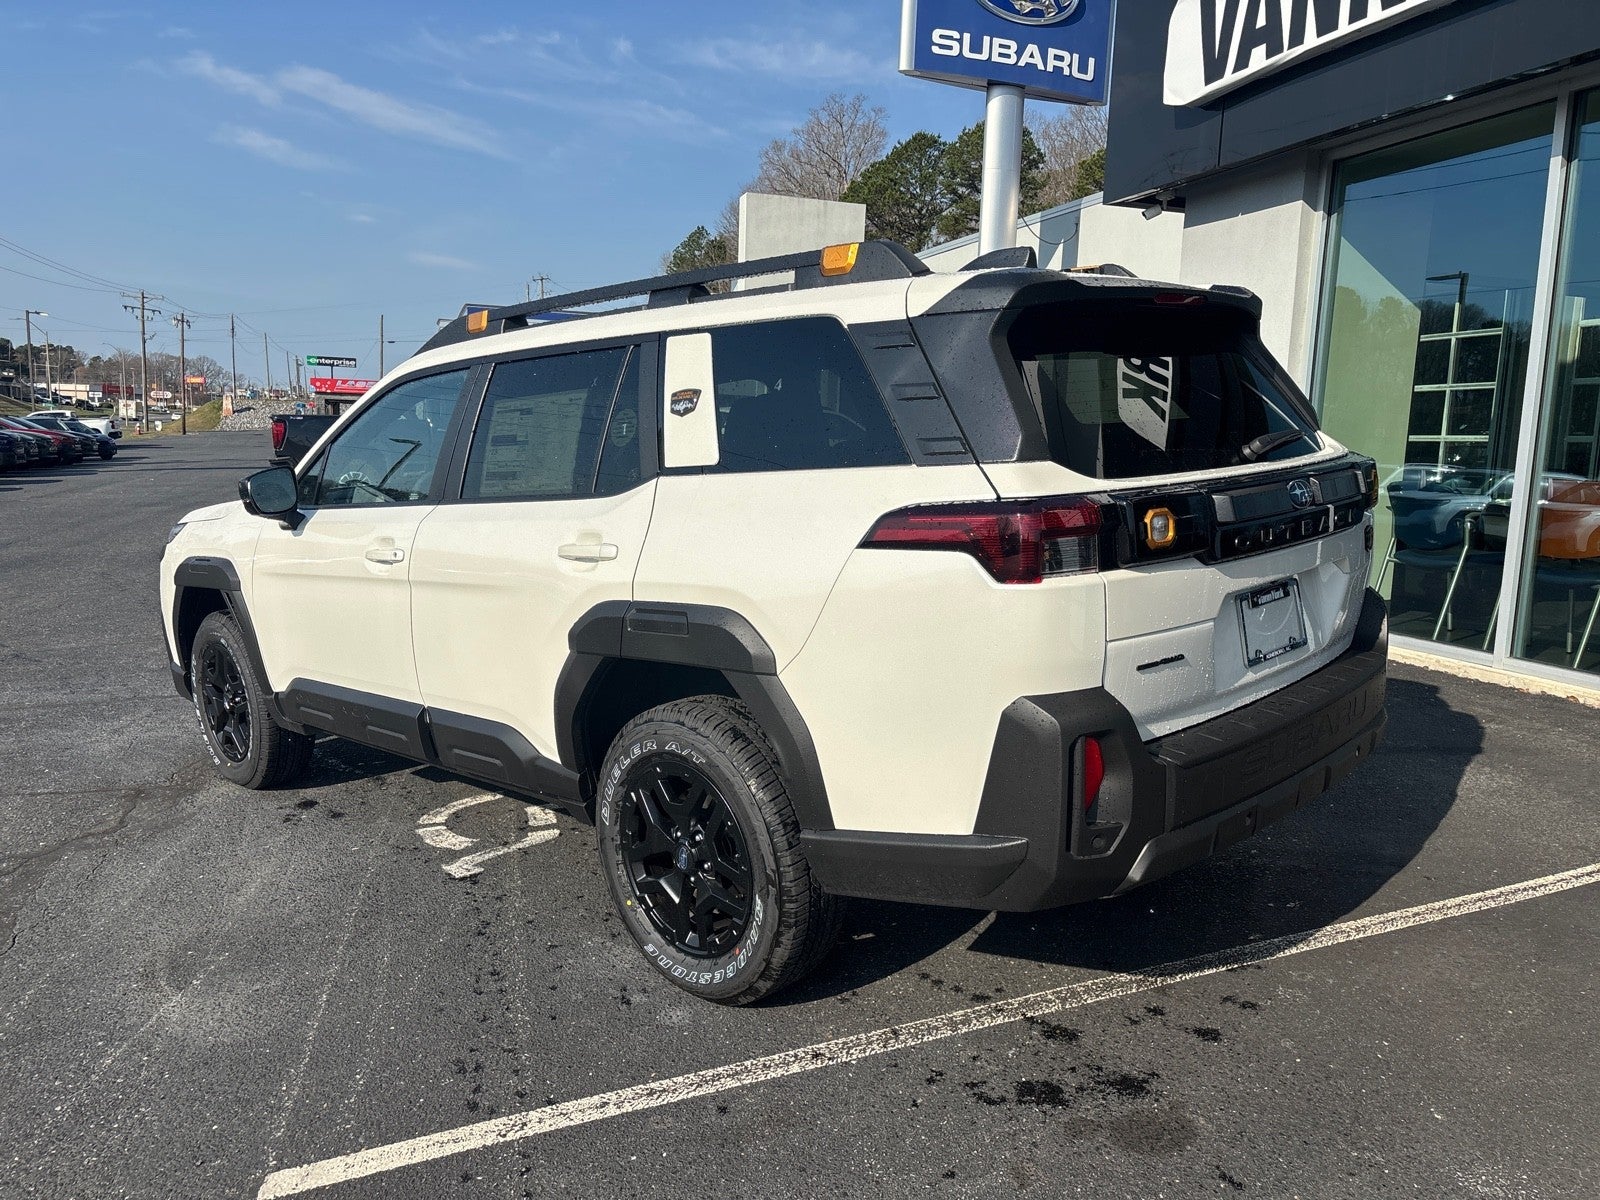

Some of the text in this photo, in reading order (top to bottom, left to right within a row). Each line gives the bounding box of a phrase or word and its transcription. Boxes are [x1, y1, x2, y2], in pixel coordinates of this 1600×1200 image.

[931, 28, 1096, 82] SUBARU
[310, 357, 356, 366] enterprise
[601, 740, 706, 826] DUELER A/T
[643, 893, 764, 985] BRIDGESTONE
